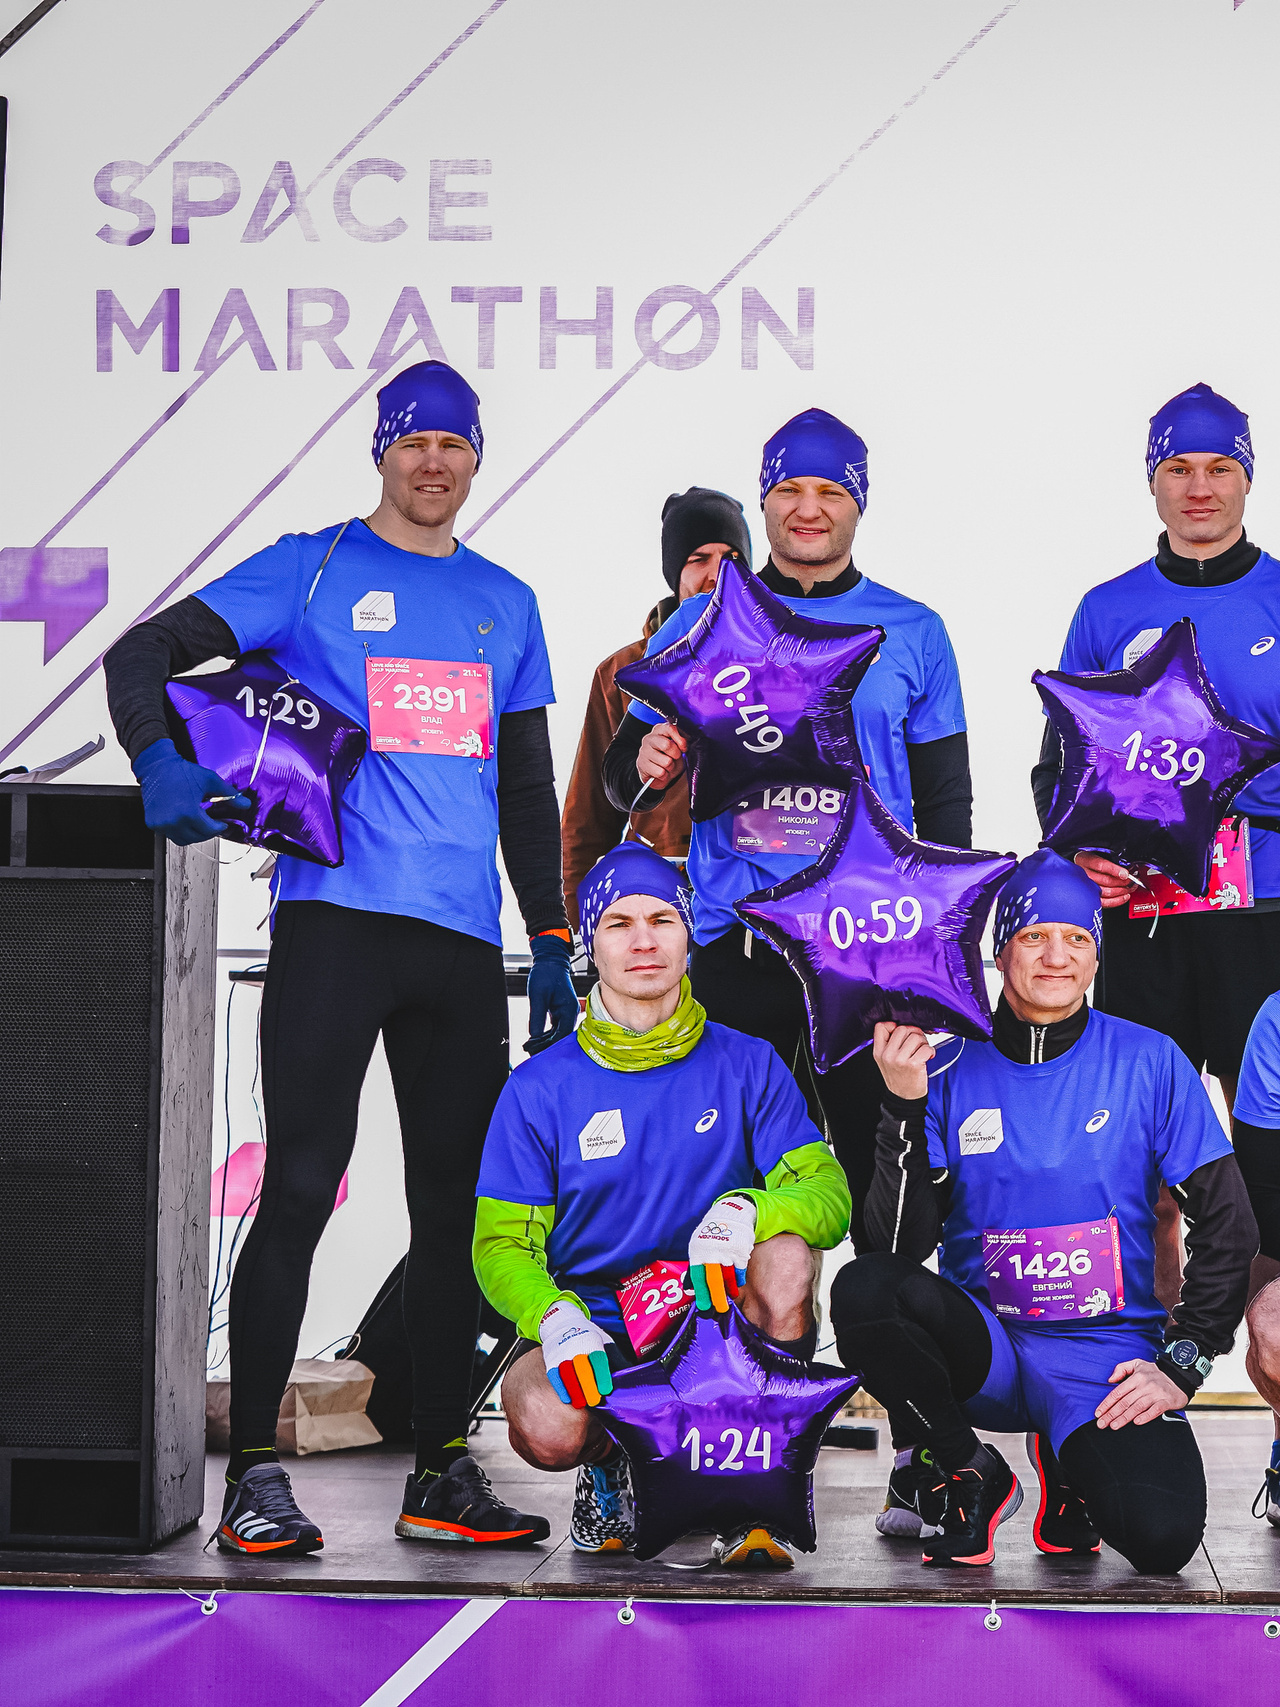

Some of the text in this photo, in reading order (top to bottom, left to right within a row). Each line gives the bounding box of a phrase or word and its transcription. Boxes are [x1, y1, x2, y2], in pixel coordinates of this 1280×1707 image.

[94, 158, 493, 246] SPACE
[96, 285, 815, 372] MARATHON
[463, 669, 477, 678] 21.1
[235, 685, 321, 730] 1:29
[393, 683, 467, 714] 2391
[712, 665, 784, 754] 0:49
[420, 716, 443, 725] ВЛАД
[1122, 730, 1206, 787] 1:39
[763, 787, 841, 814] 1408
[778, 816, 819, 825] НИКОЛАЙ
[828, 895, 923, 950] 0:59
[587, 1139, 618, 1148] MARATHON
[1090, 1226, 1101, 1236] 10
[1008, 1248, 1092, 1280] 1426
[1032, 1279, 1073, 1292] ЕВГЕНИЙ
[680, 1426, 772, 1471] 1:24
